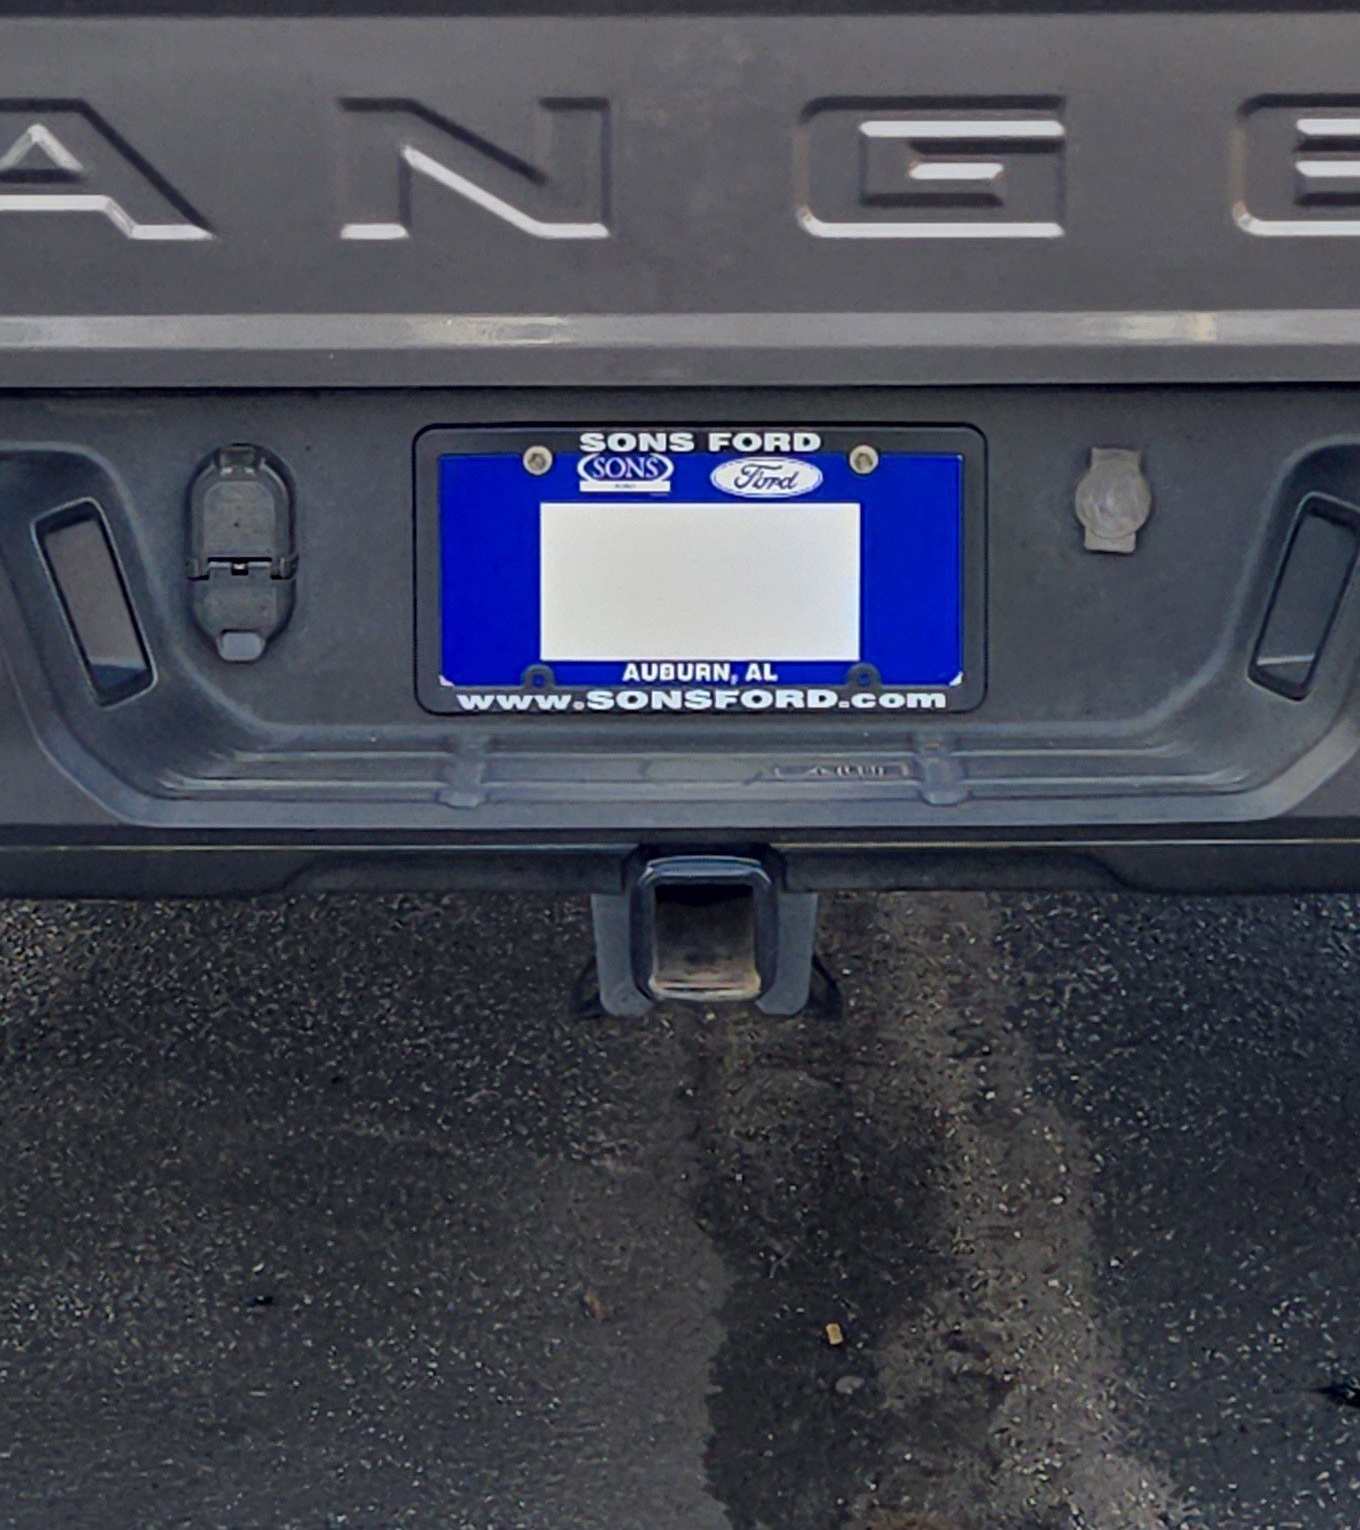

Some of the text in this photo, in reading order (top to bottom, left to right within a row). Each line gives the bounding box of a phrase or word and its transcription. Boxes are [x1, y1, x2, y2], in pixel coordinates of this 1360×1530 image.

[579, 432, 822, 453] SONS FORD
[592, 456, 661, 481] SONS
[733, 462, 798, 490] Ford
[621, 662, 779, 685] AUBURN, AL
[456, 689, 947, 711] www.SONSFORD.com
